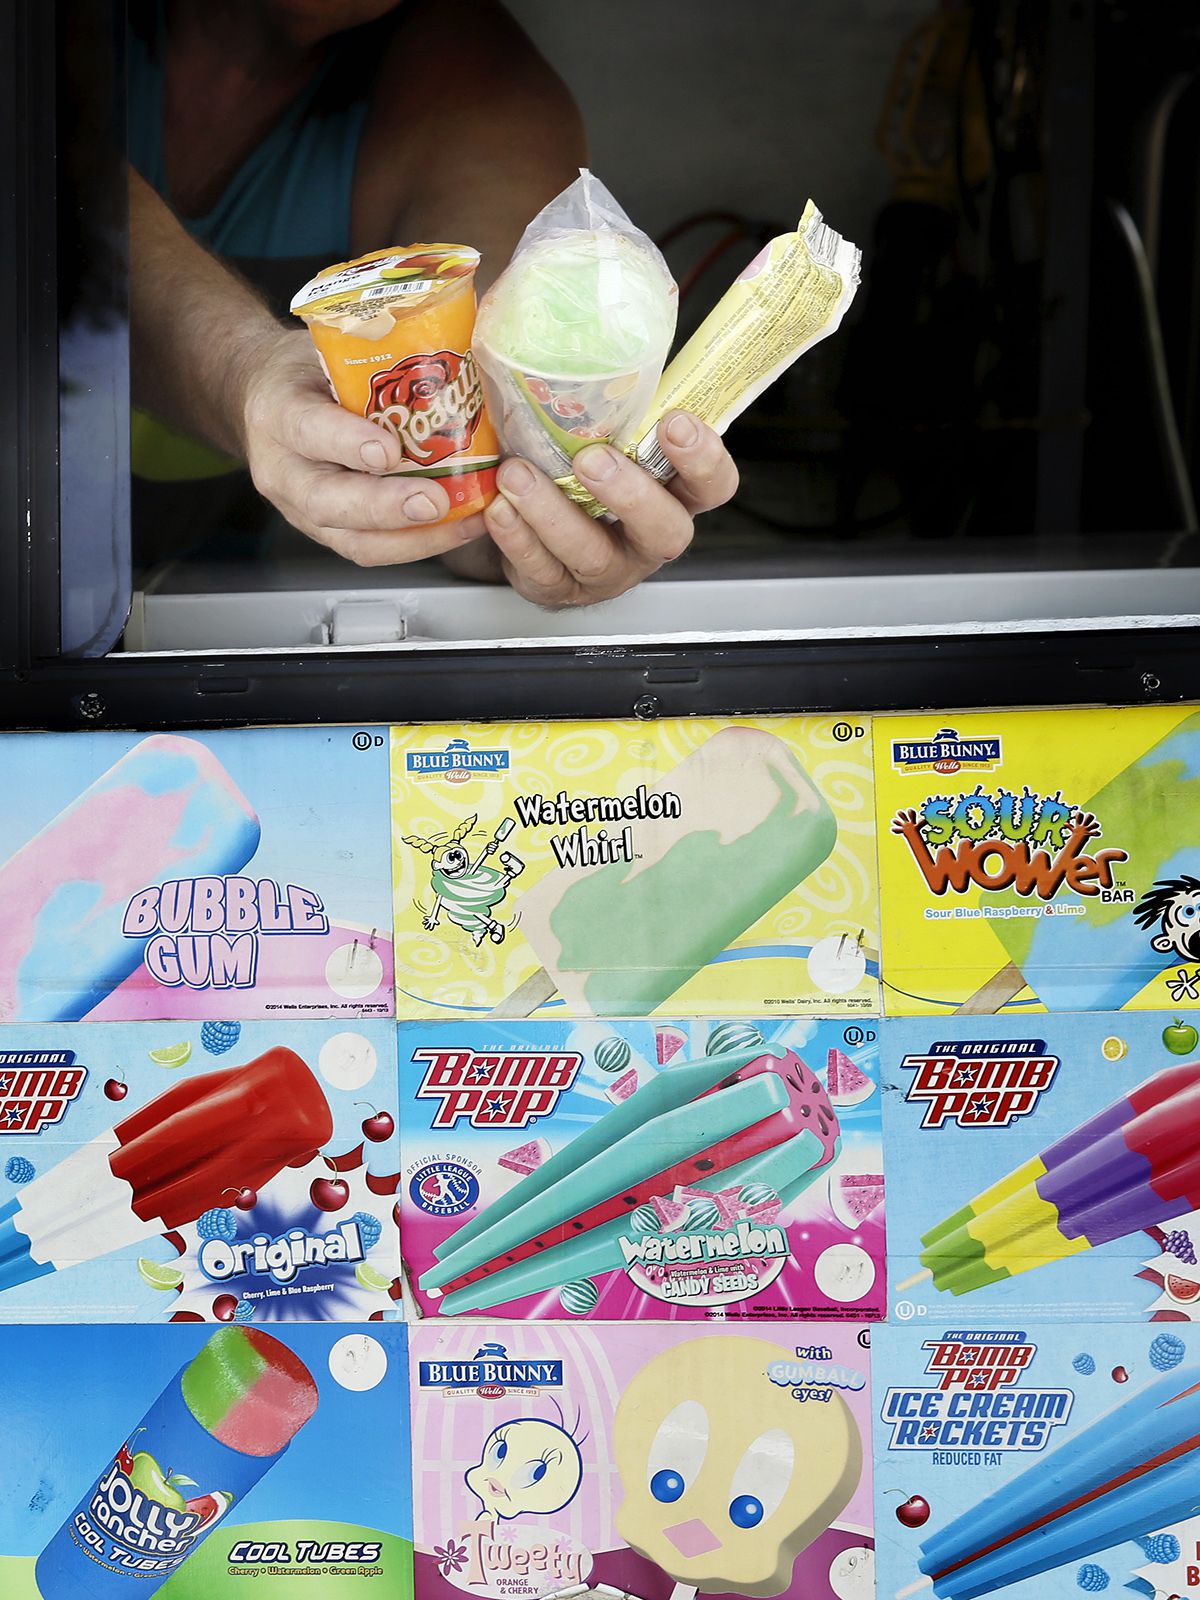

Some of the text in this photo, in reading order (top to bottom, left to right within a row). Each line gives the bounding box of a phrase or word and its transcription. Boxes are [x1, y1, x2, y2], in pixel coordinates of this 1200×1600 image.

[311, 274, 360, 293] Mango
[344, 353, 393, 366] Since 1912
[413, 754, 449, 768] BLUE
[900, 744, 938, 759] BLUE
[933, 761, 960, 773] Wells
[514, 785, 682, 828] Watermelon
[919, 786, 1078, 850] SOUR
[550, 826, 633, 869] Whirl
[123, 876, 330, 937] BUBBLE
[1101, 890, 1134, 903] BAR
[925, 905, 1085, 919] Sour Blue Raspberry & Lime
[146, 932, 259, 989] GUM
[412, 1048, 582, 1089] BOMB
[901, 1055, 1060, 1090] BOMB
[419, 1089, 559, 1128] POP
[907, 1090, 1038, 1128] POP
[407, 1153, 483, 1175] OFFICIAL SPONSOR
[421, 1200, 471, 1215] BASEBALL
[201, 1222, 366, 1282] Original
[618, 1222, 787, 1264] Watermelon
[796, 1346, 832, 1360] with
[922, 1340, 1037, 1368] BOMB
[429, 1364, 480, 1383] BLUE
[771, 1364, 859, 1384] GUMBALL
[926, 1368, 1021, 1391] POP
[792, 1388, 832, 1402] eyes!
[887, 1392, 1068, 1419] ICE CREAM
[896, 1420, 1048, 1446] ROCKETS
[932, 1452, 1003, 1466] REDUCED FAT
[100, 1465, 194, 1538] JOLLY
[229, 1541, 383, 1563] COOL TUBES
[460, 1519, 585, 1586] Tweety
[496, 1578, 529, 1586] ORANGE
